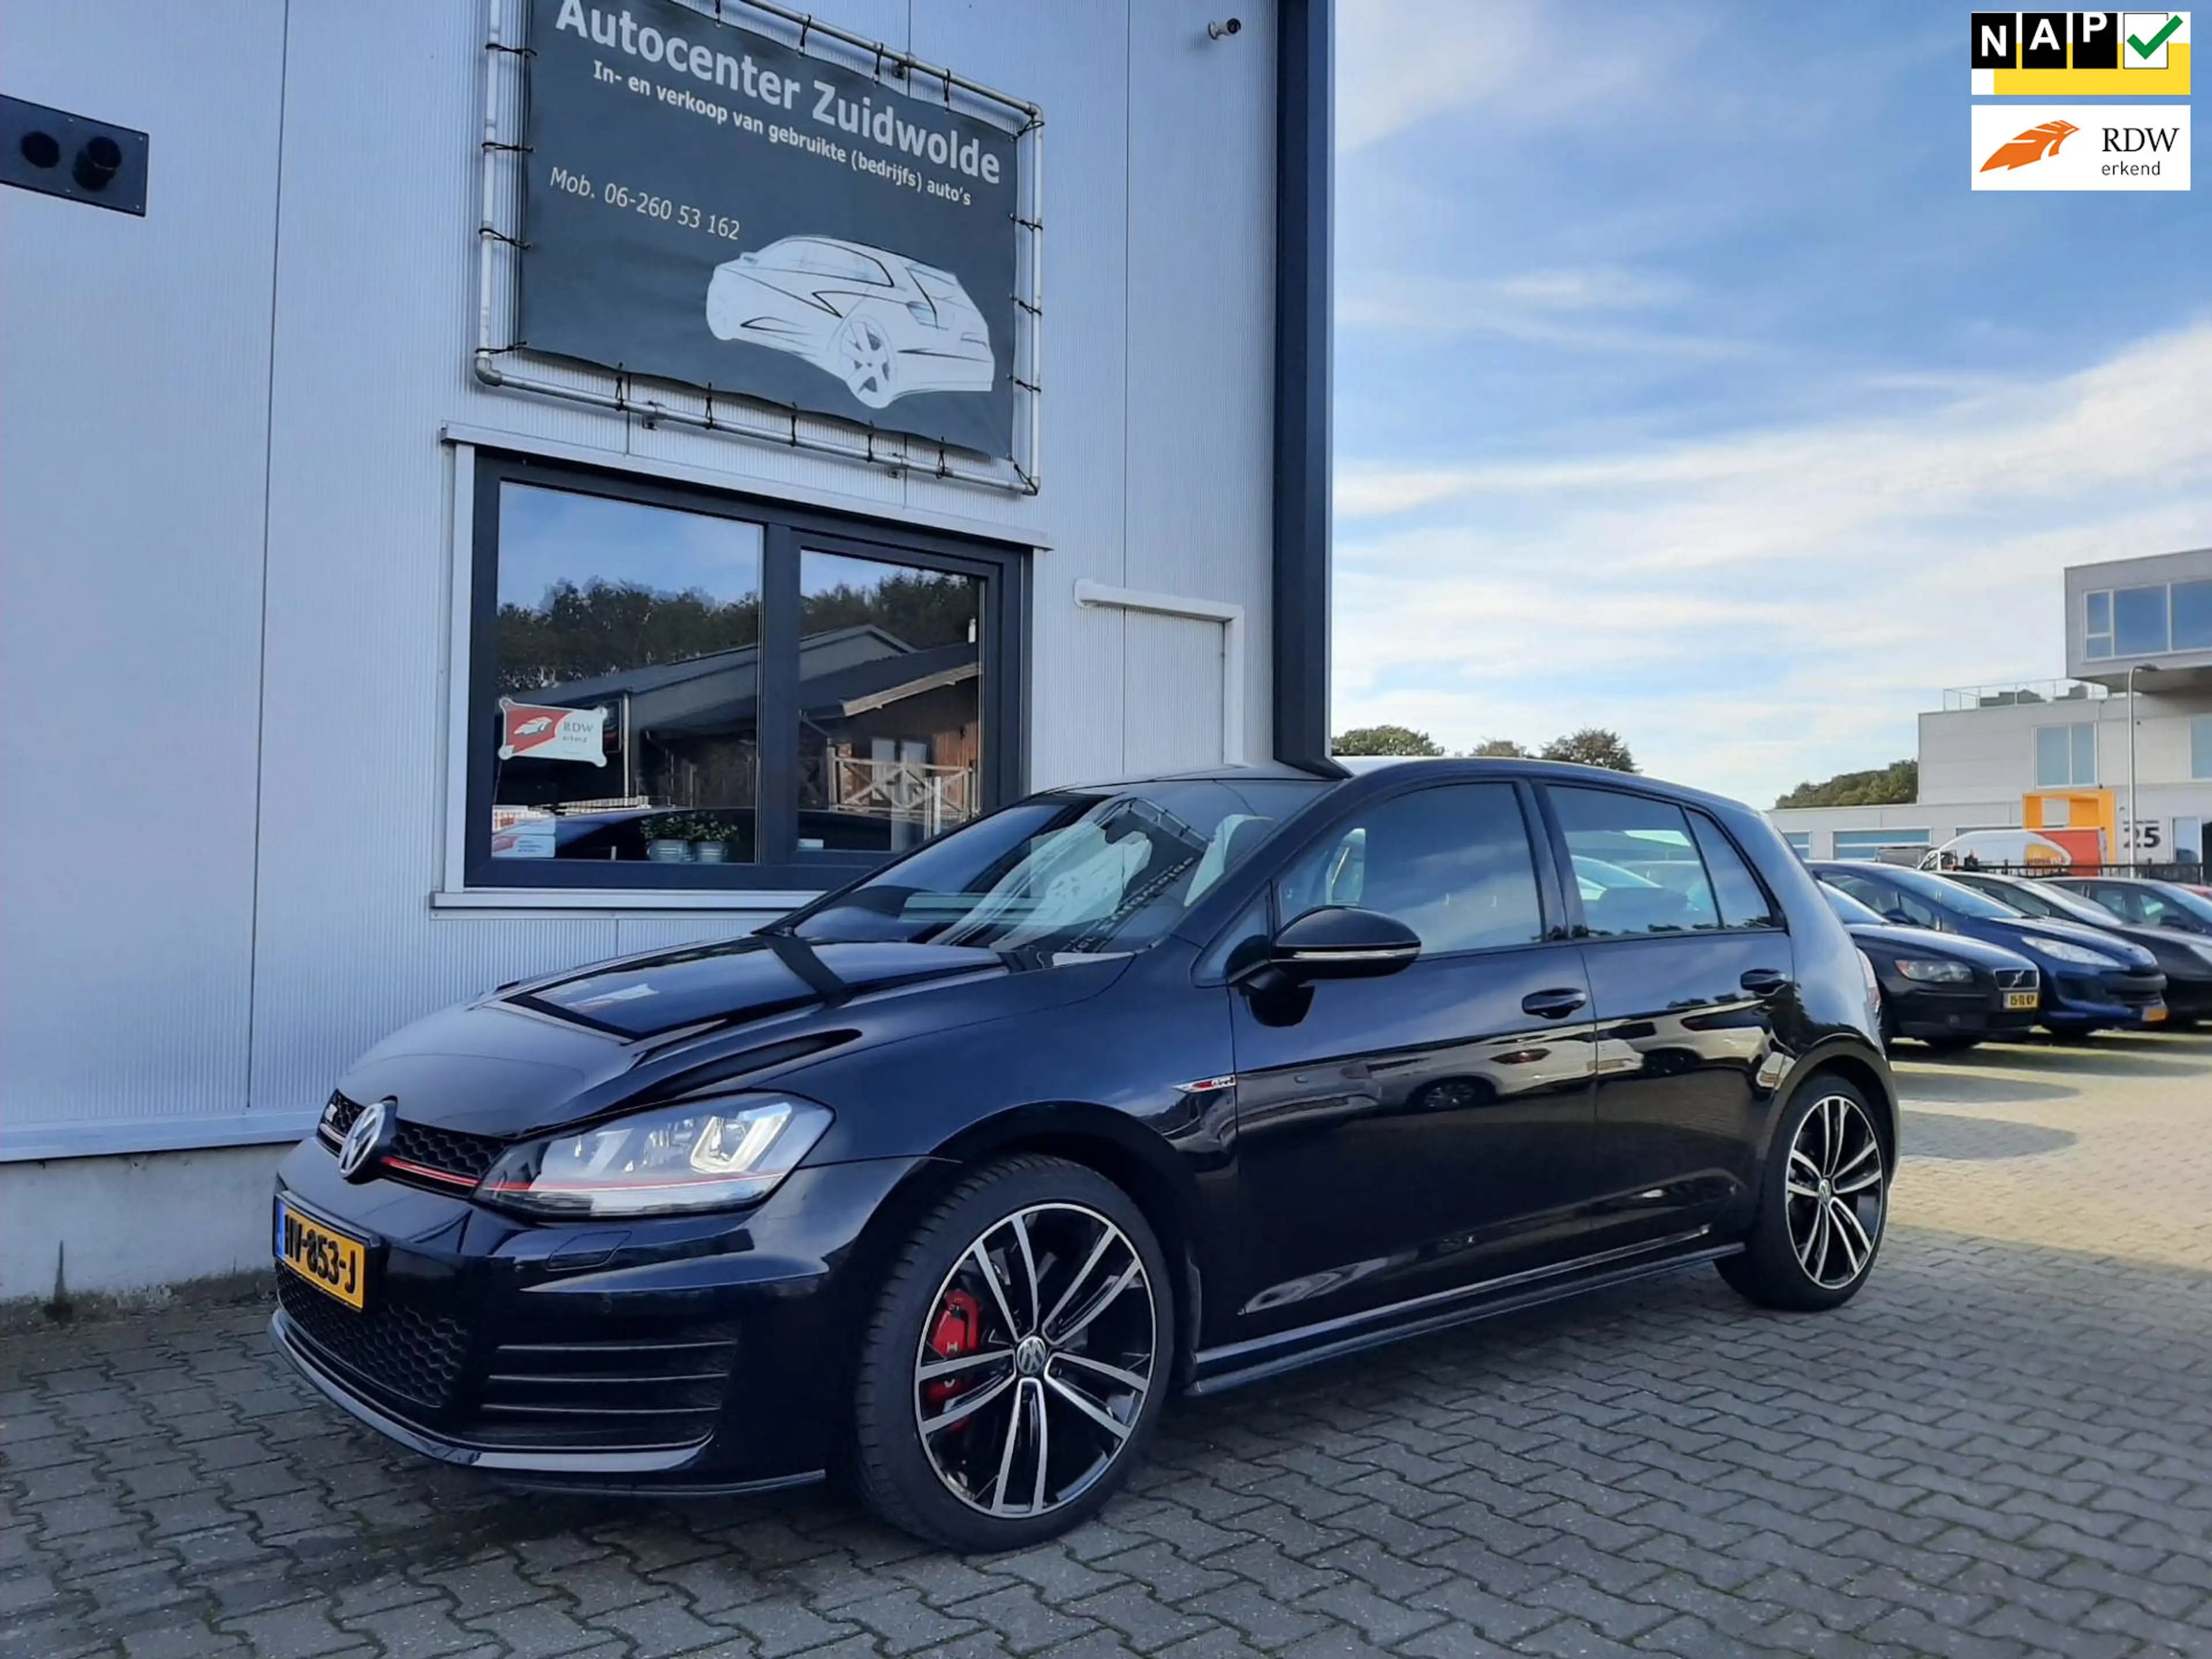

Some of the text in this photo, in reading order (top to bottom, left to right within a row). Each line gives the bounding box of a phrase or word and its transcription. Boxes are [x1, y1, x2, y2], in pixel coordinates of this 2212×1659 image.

[555, 0, 1000, 183] Autocenter Zuidwolde
[593, 60, 971, 206] In- en verkoop van gebruikte (bedrijfs) auto's
[550, 167, 740, 240] Mob. 06-260 53 162
[563, 721, 594, 732] RDW
